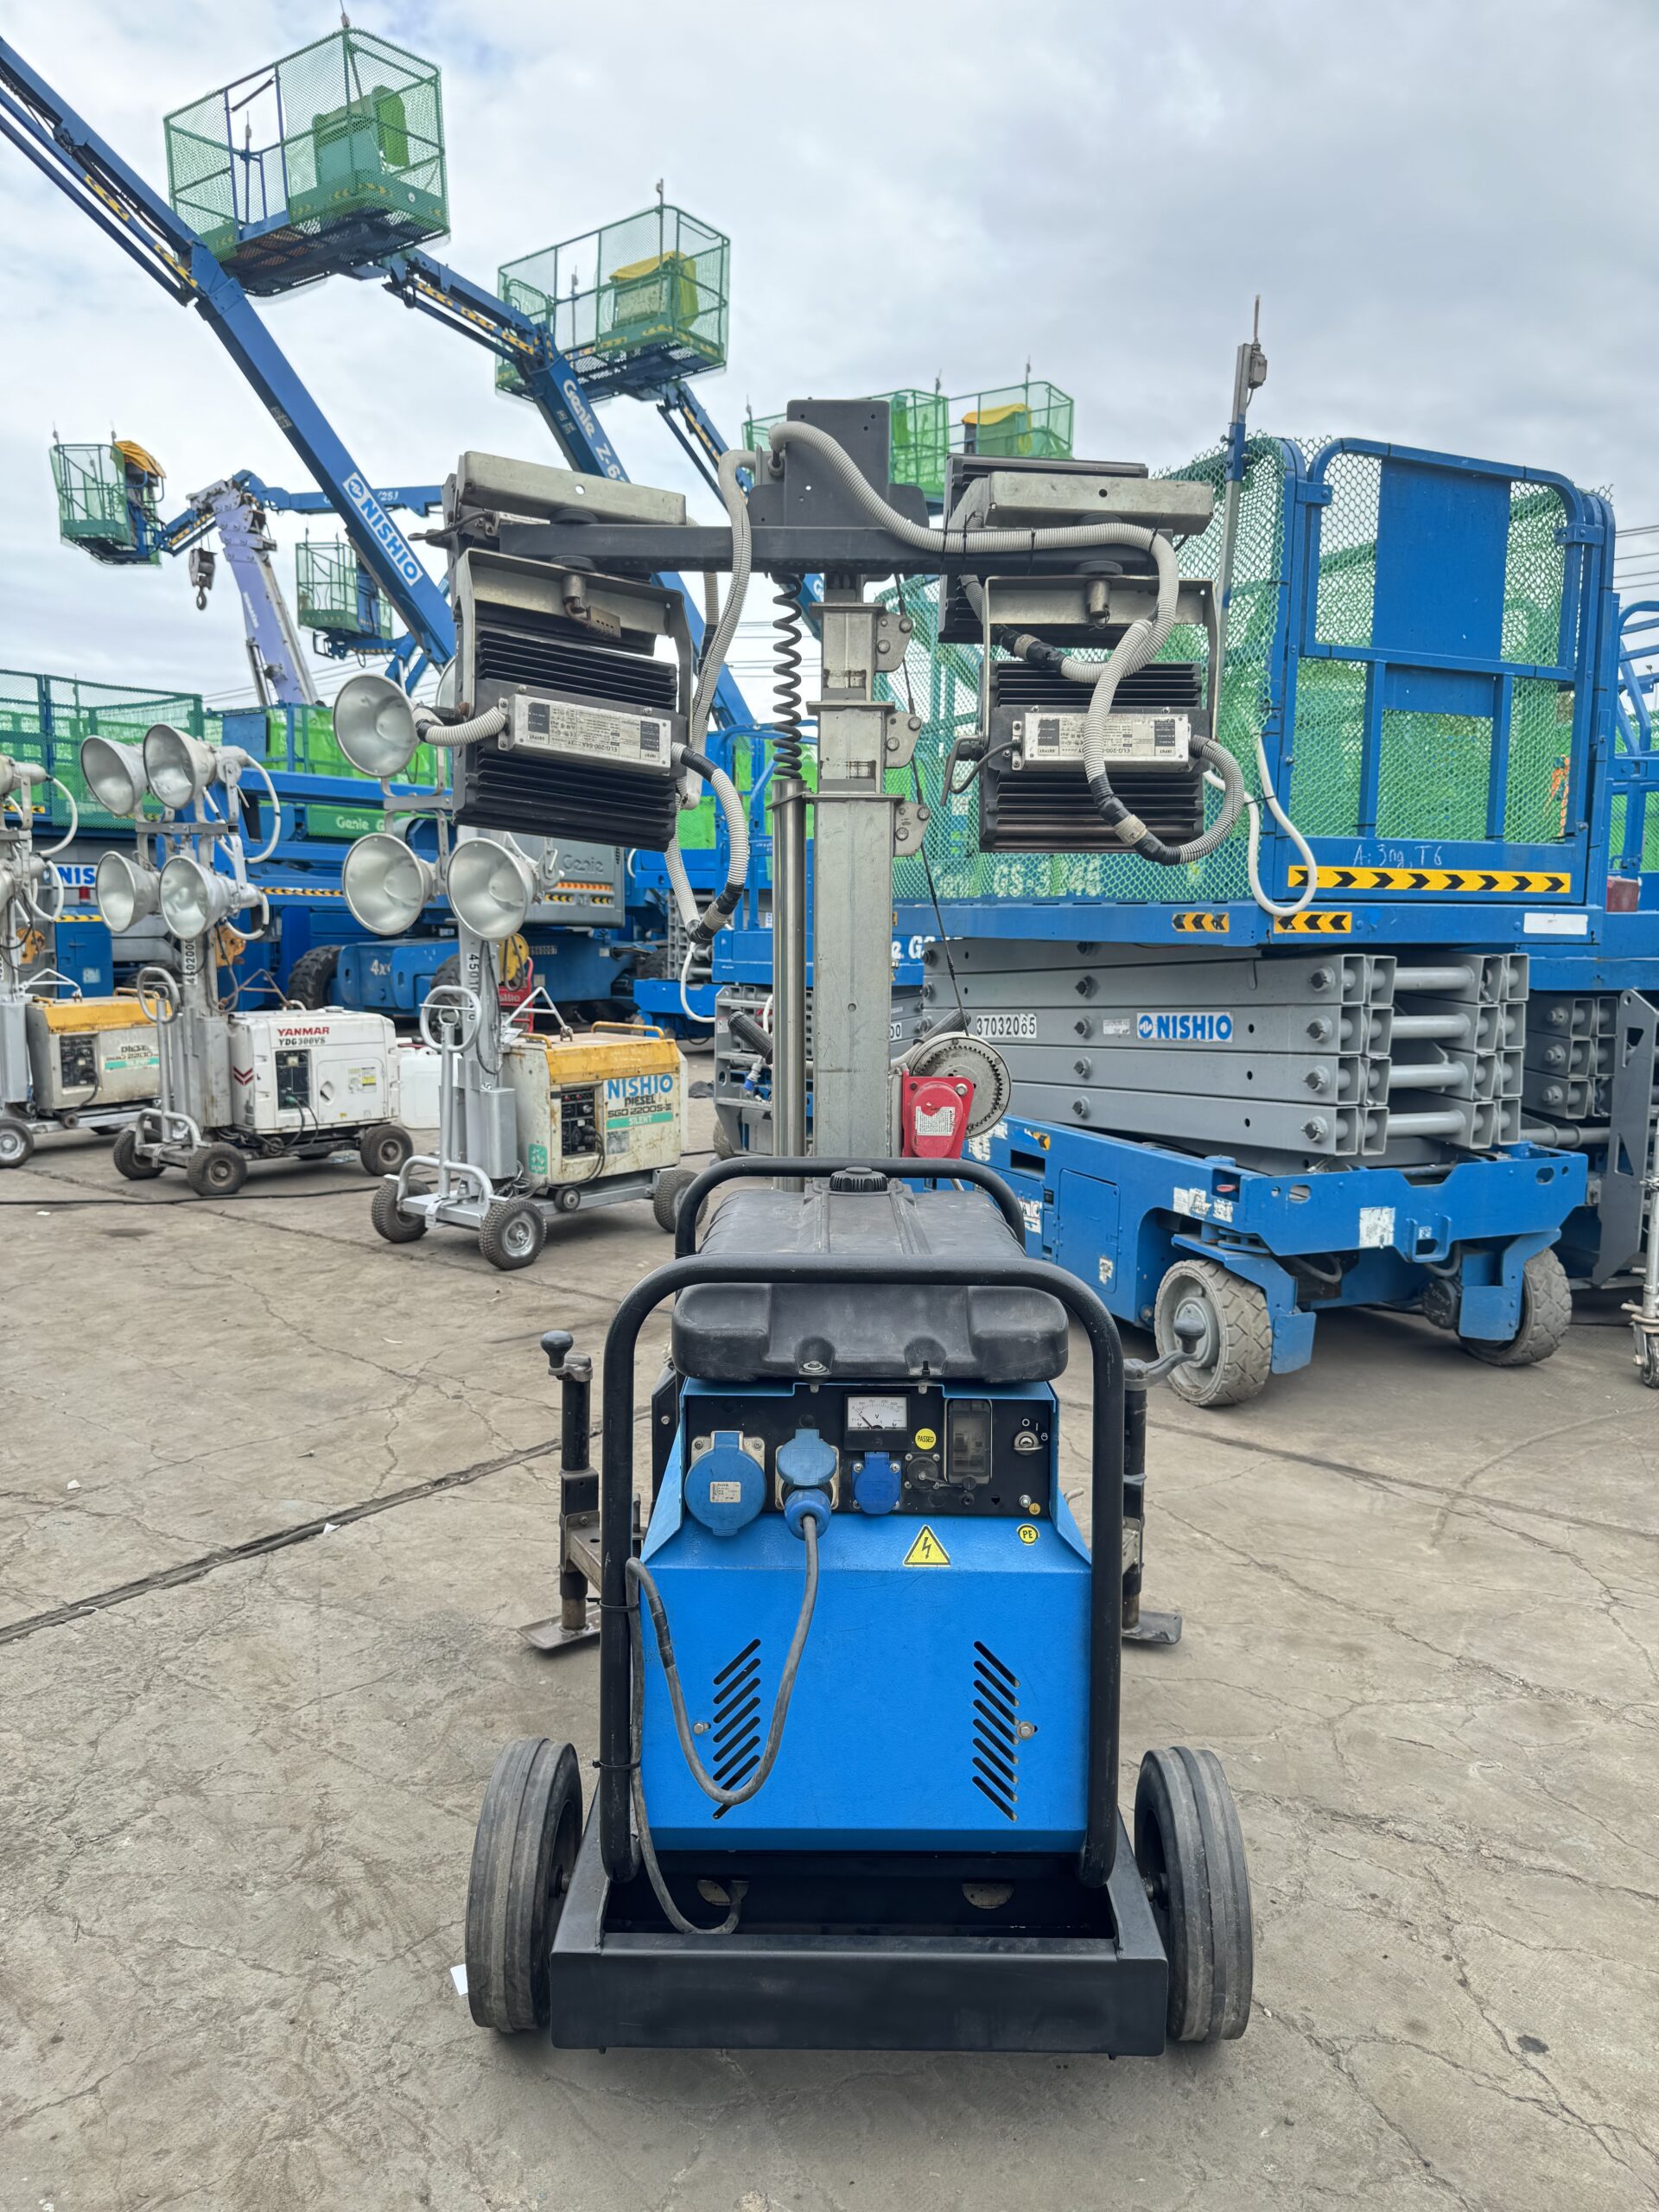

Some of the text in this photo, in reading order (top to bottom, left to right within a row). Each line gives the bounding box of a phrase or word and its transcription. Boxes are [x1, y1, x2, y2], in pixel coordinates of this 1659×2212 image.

[563, 379, 595, 440] Genie
[595, 442, 626, 482] Z-6
[360, 498, 418, 580] NISHIO
[335, 816, 370, 831] Genie
[563, 854, 604, 874] Genie
[57, 867, 96, 885] NIS
[277, 1027, 329, 1037] YANMAR
[1157, 1014, 1233, 1040] NISHIO
[607, 1074, 673, 1100] NISHIO
[625, 1096, 656, 1108] DIESEL
[629, 1116, 652, 1124] SILENT
[1022, 1530, 1033, 1539] PE
